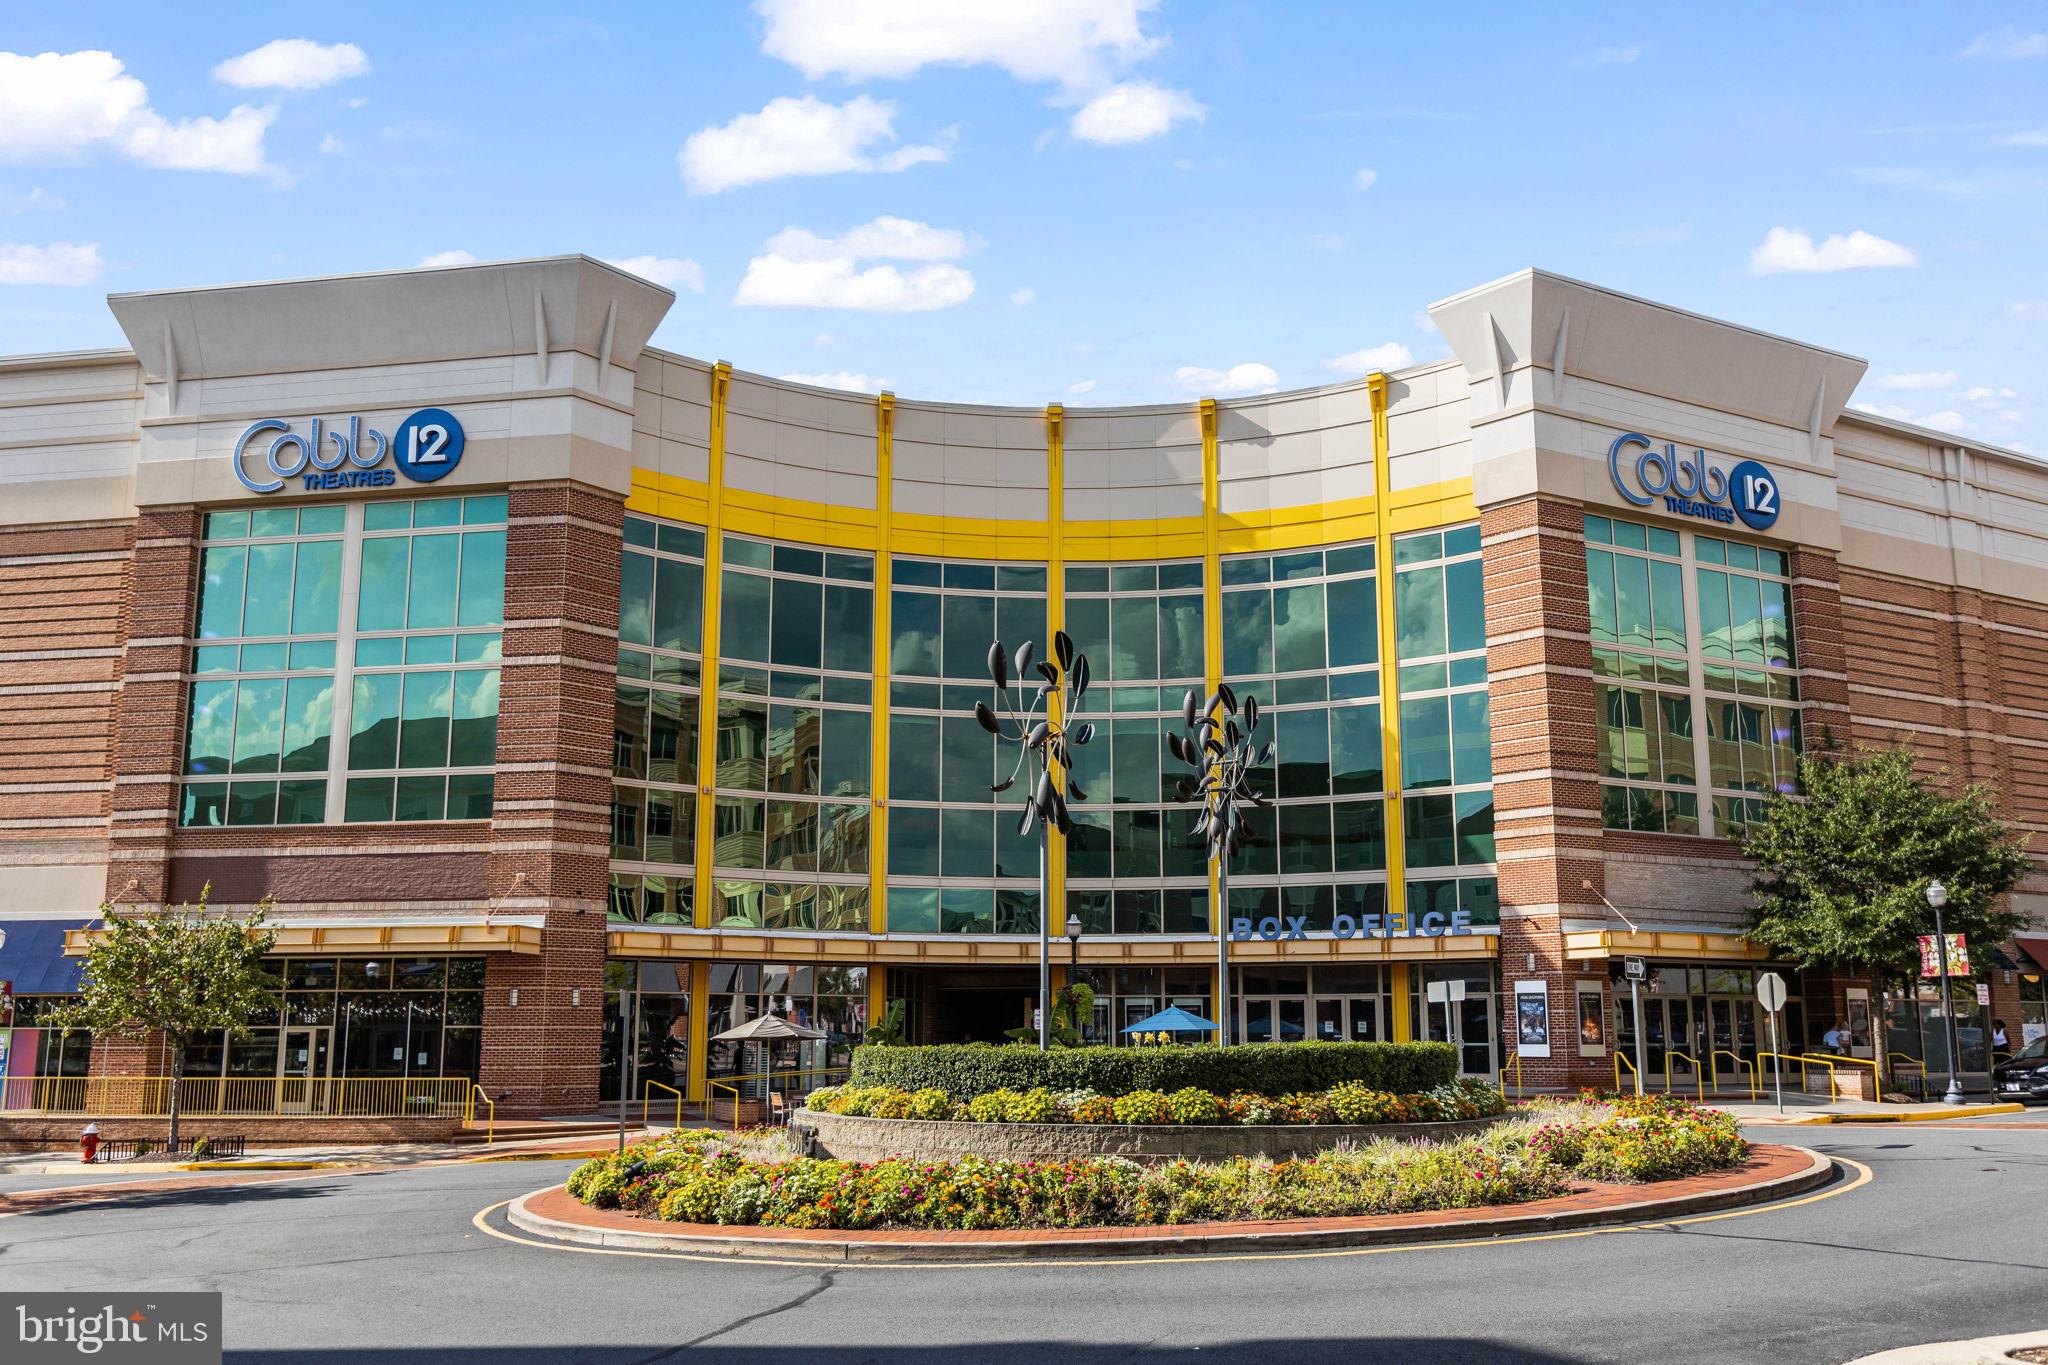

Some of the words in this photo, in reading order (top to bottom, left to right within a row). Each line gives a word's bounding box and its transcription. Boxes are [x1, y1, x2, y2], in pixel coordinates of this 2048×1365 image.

[233, 415, 389, 493] Cobb
[407, 424, 449, 464] 12
[303, 468, 396, 490] THEATRES
[1607, 432, 1729, 506] Cobb
[1743, 474, 1776, 514] 12
[1664, 495, 1736, 524] THEATRES
[1232, 916, 1308, 941] BOX
[1332, 911, 1472, 938] OFFICE
